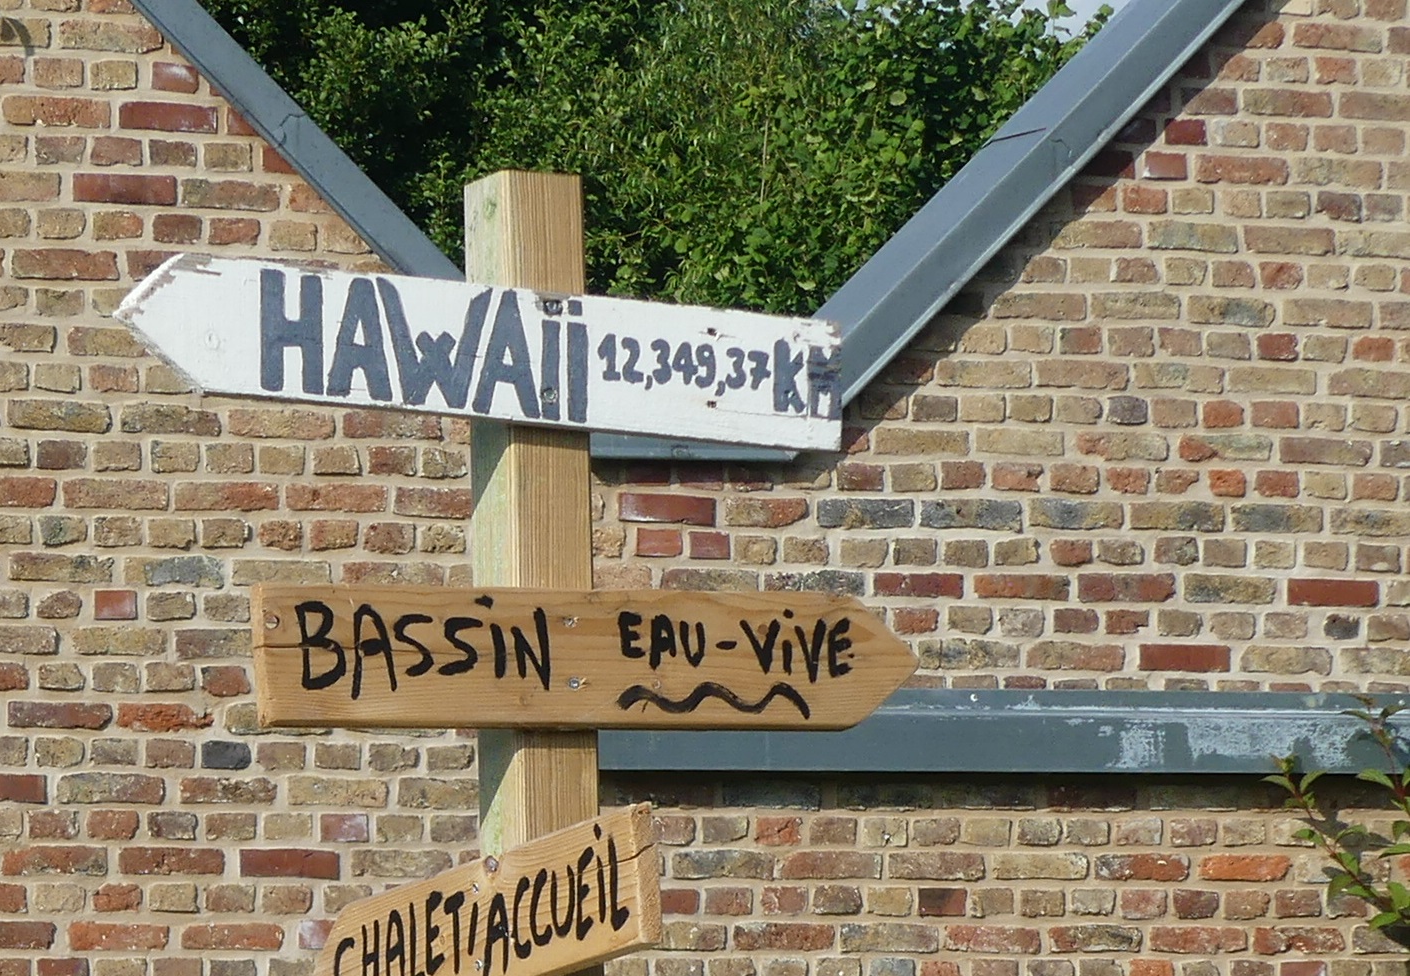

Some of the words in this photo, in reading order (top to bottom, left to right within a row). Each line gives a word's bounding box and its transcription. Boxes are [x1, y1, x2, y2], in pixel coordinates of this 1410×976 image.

[259, 266, 589, 423] HAWAii
[294, 594, 551, 700] BASSiN
[617, 608, 855, 683] EAU-ViVE
